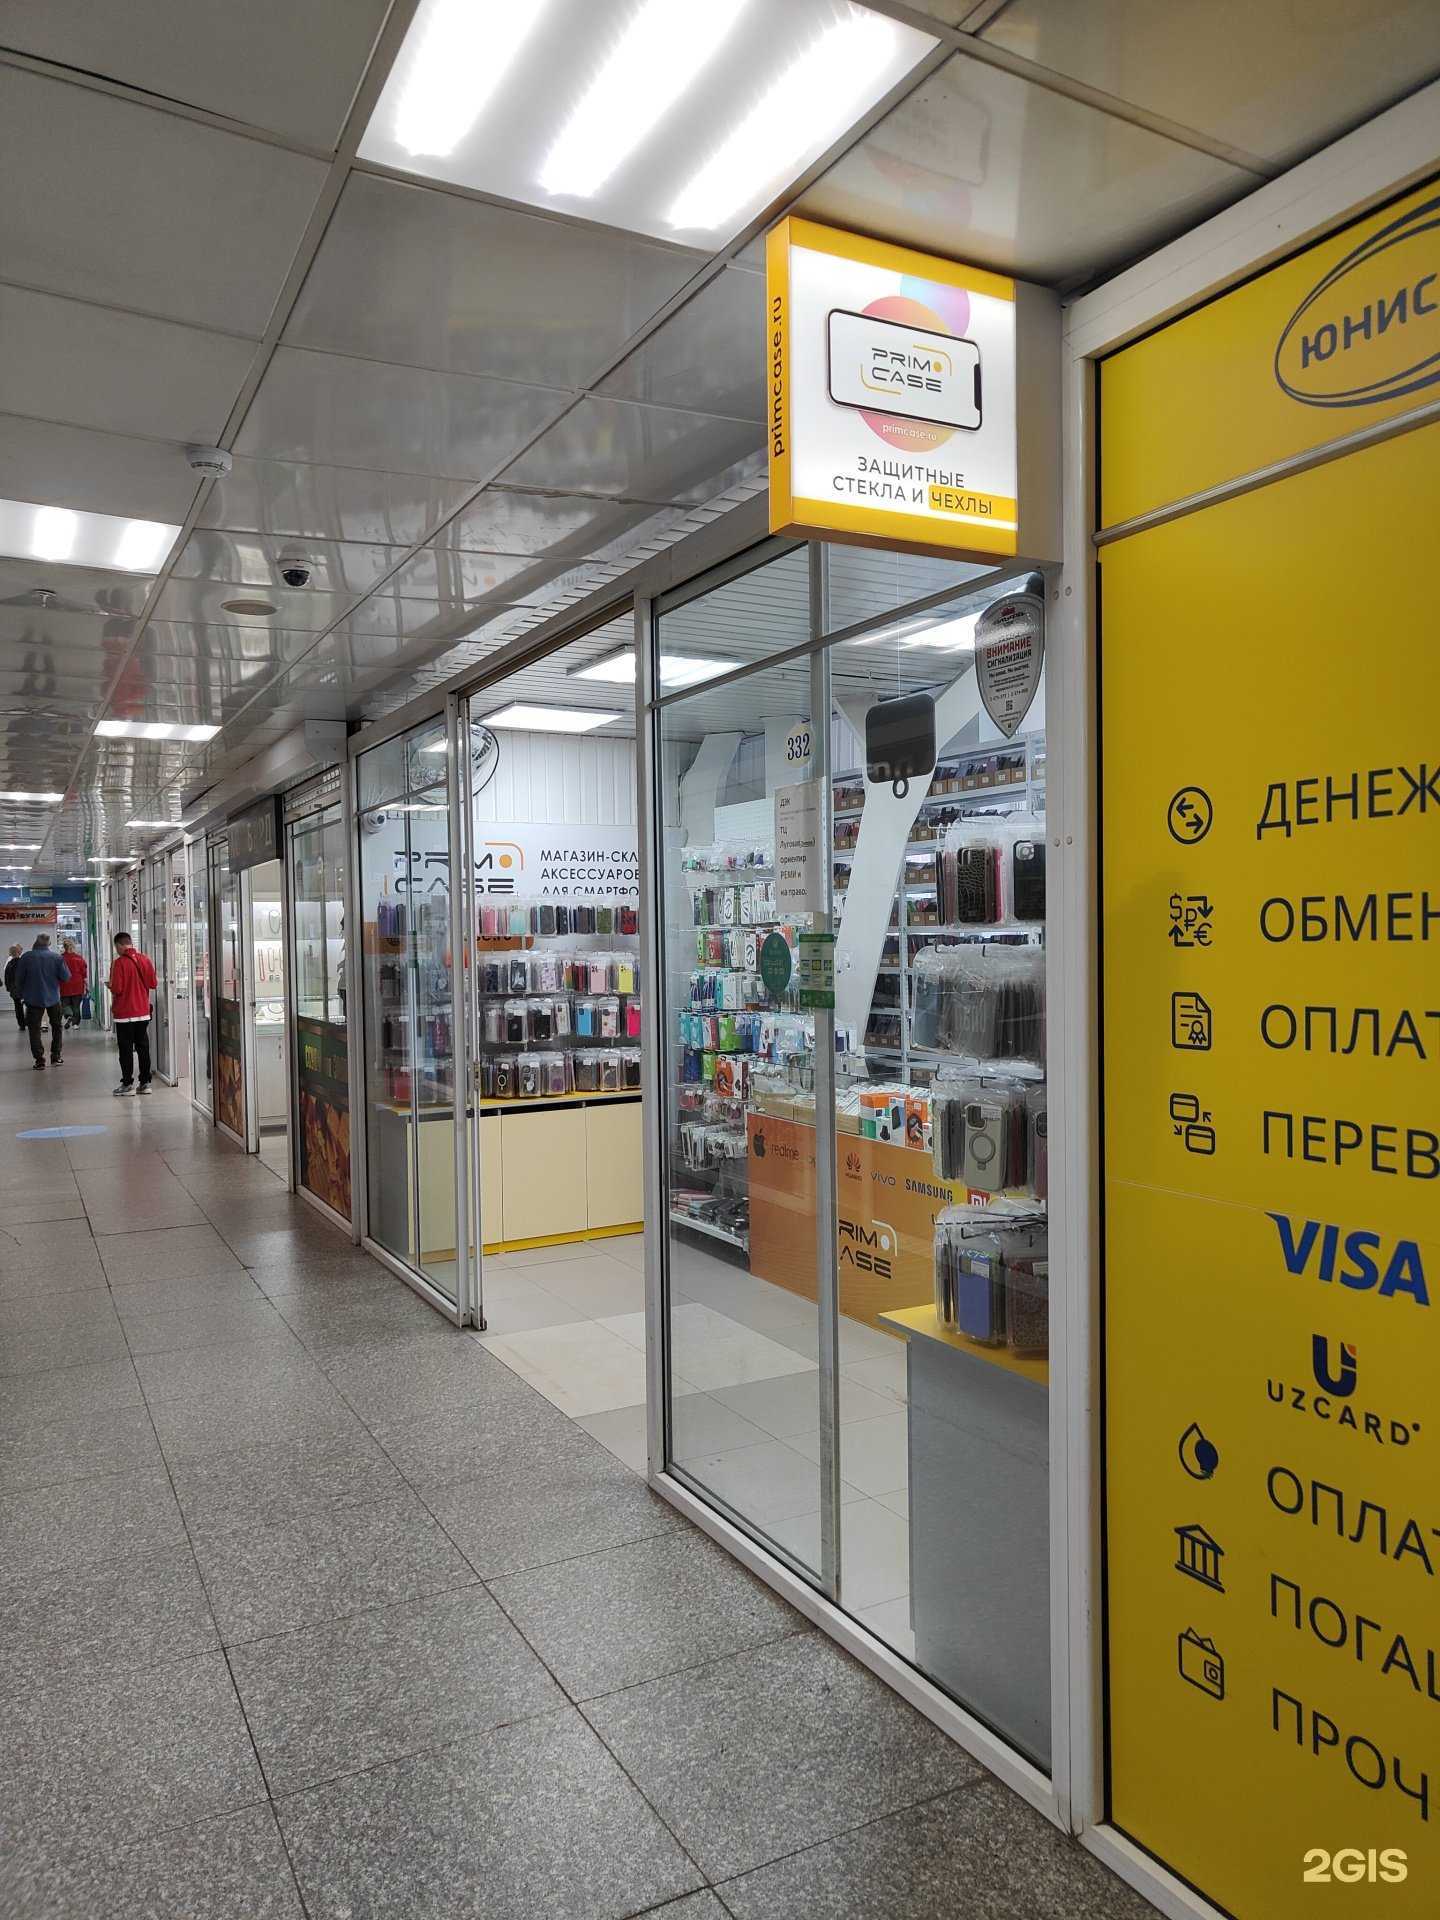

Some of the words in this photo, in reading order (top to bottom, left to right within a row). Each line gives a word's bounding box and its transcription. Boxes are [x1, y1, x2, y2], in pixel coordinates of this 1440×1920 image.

[1302, 273, 1438, 369] ЮНИС
[772, 295, 784, 458] primcase.ru
[871, 366, 942, 393] CASE
[882, 422, 938, 442] primcase.ru
[858, 456, 964, 489] ЗАЩИТНЫЕ
[832, 475, 906, 502] СТЕКЛА
[912, 488, 924, 504] И
[931, 491, 993, 515] ЧЕХЛЫ
[986, 635, 1032, 660] ВНИМАНИЕ
[787, 733, 810, 761] 332
[1256, 763, 1440, 840] ДЕНЕЖ
[771, 1142, 800, 1161] realme
[1263, 1110, 1440, 1180] ПЕРЕВ
[870, 1170, 896, 1186] vivo
[905, 1177, 953, 1202] SAMSUNG
[838, 1219, 878, 1249] RIM
[839, 1246, 892, 1280] ASE
[1264, 1211, 1430, 1307] VISA
[1267, 1378, 1411, 1446] UZCARD
[1267, 1465, 1440, 1577] ОПЛА
